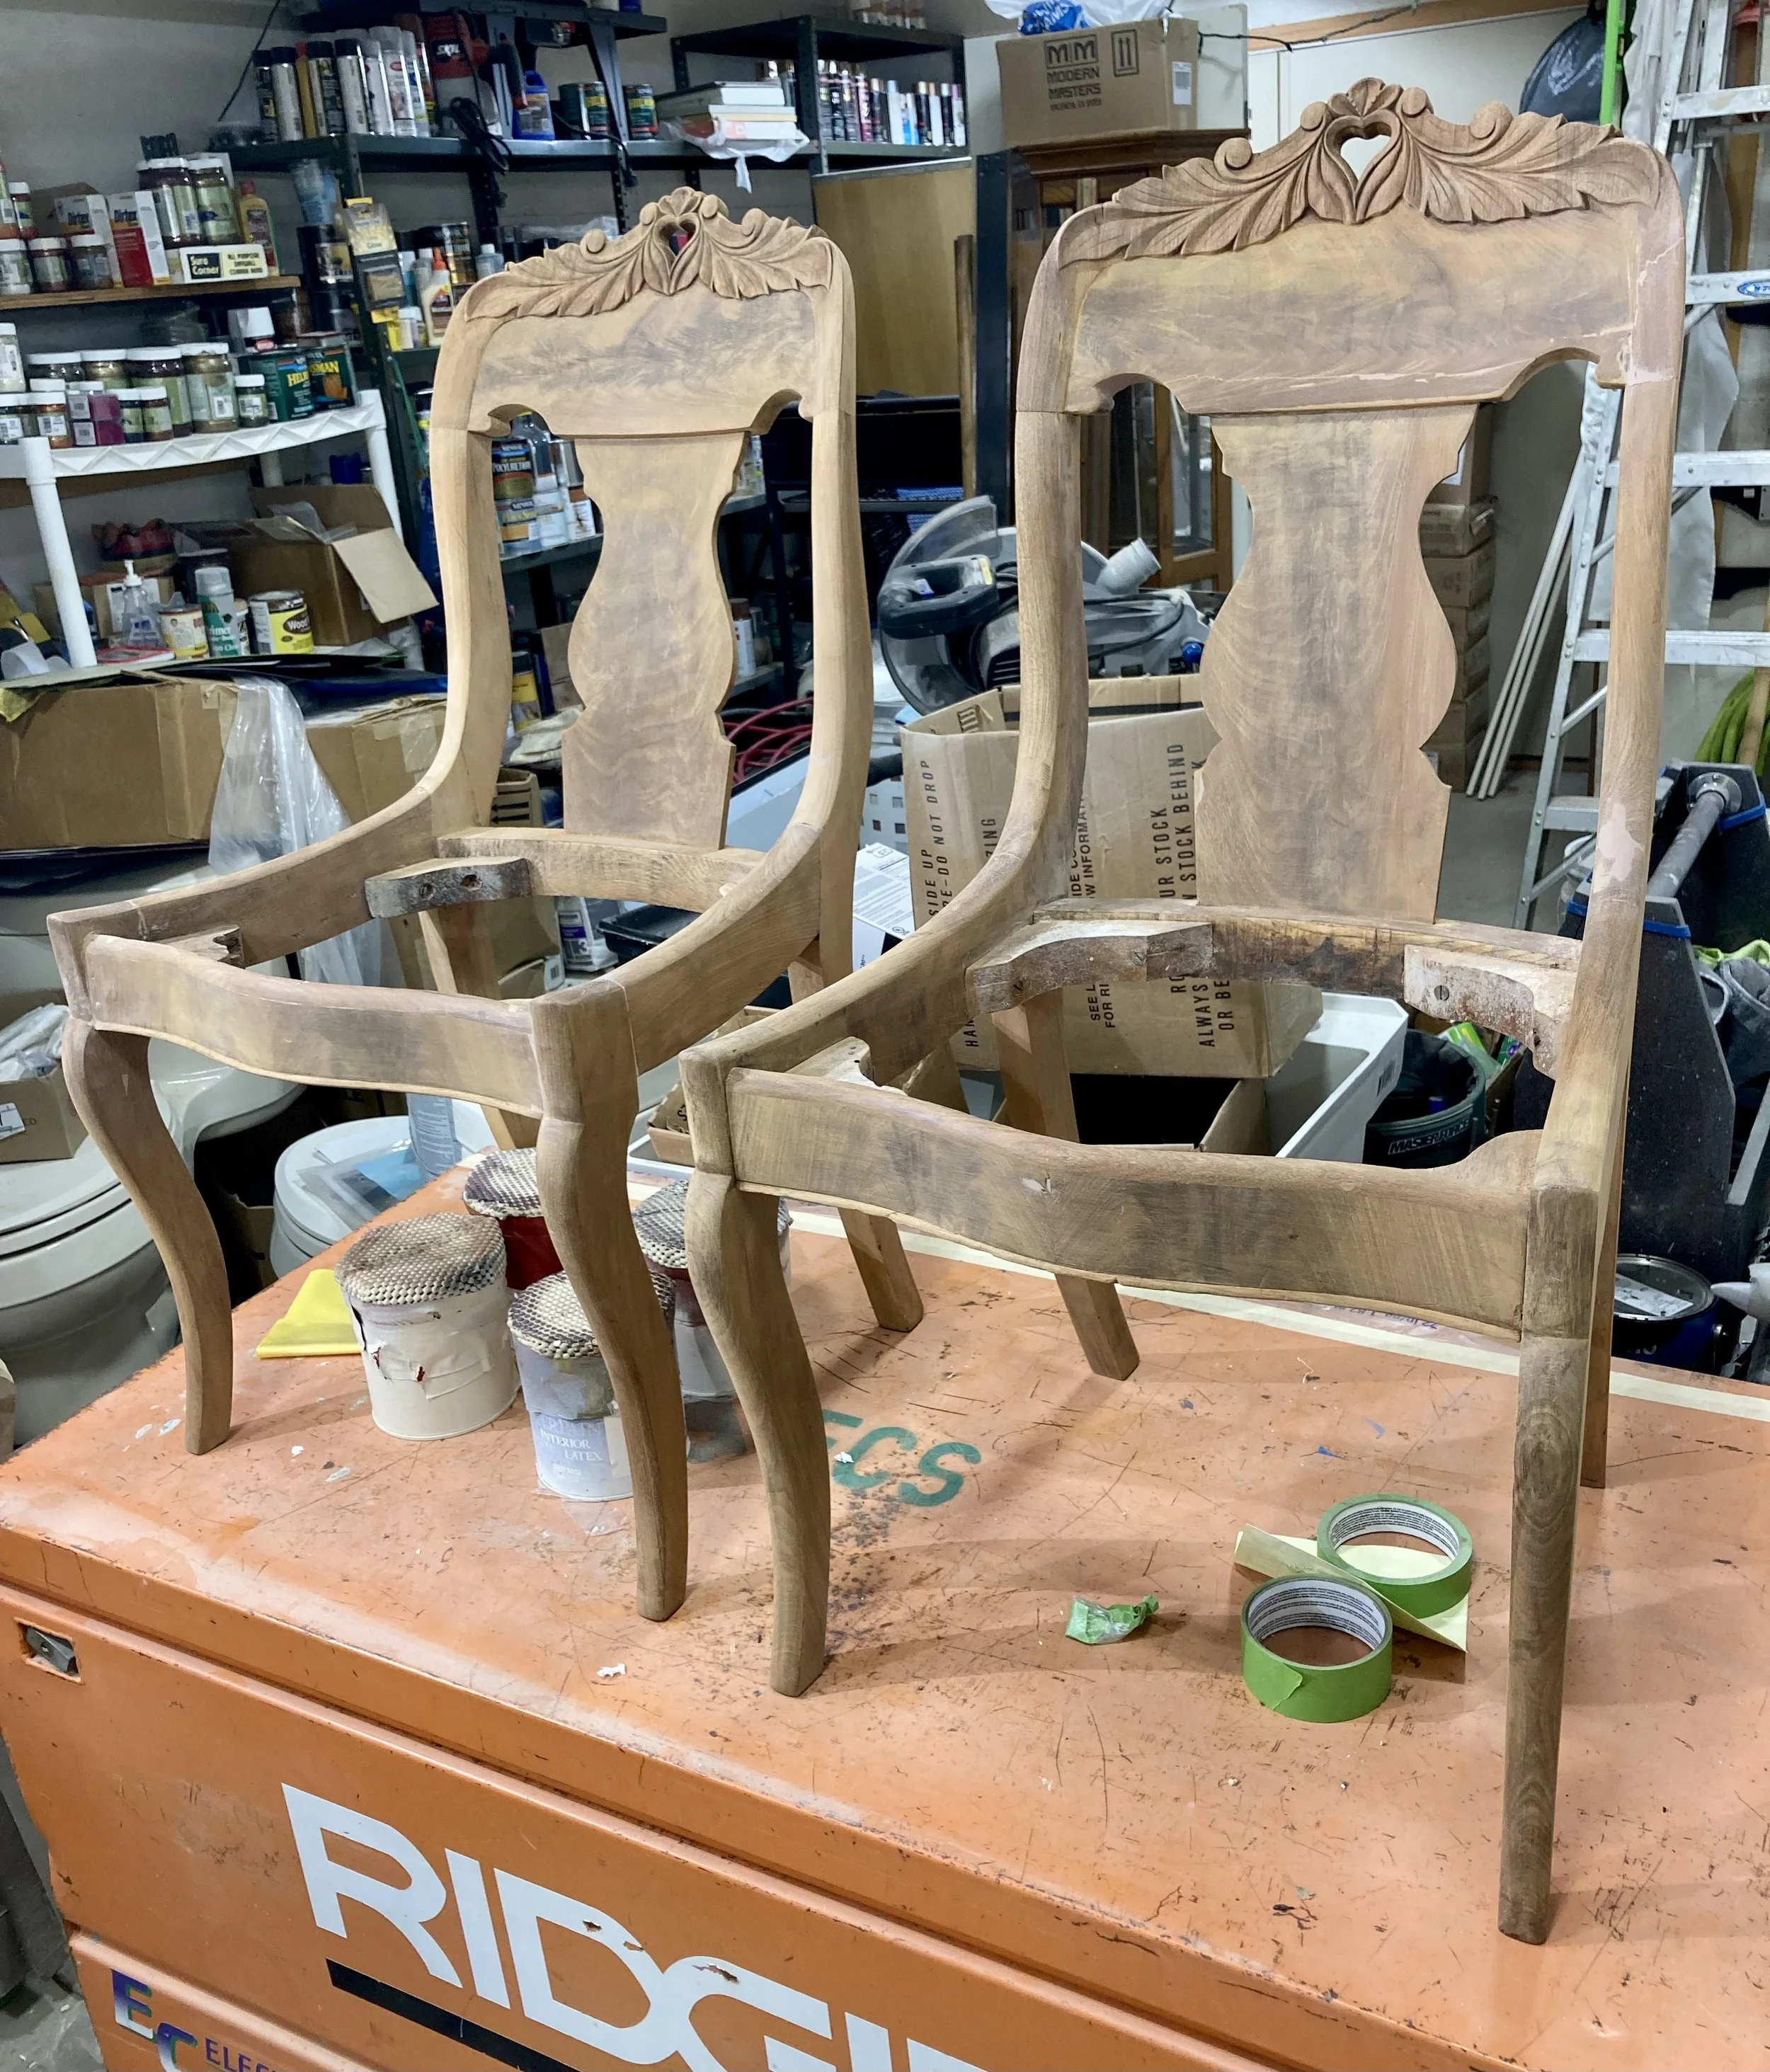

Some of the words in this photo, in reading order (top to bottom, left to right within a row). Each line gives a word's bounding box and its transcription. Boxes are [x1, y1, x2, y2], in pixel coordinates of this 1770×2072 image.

[1046, 67, 1100, 84] MODERN
[1049, 82, 1102, 100] MASTERS
[920, 760, 939, 803] DROP
[1167, 744, 1191, 813] BEHIND
[930, 815, 945, 845] NOT
[1150, 808, 1172, 865] STOCK
[921, 849, 934, 869] UP
[1174, 825, 1197, 881] STOCK
[924, 879, 940, 916] SIDE
[1214, 980, 1232, 1000] BE
[1087, 996, 1101, 1021] SEE
[1102, 1002, 1116, 1028] FOR
[1192, 985, 1215, 1048] ALWAYS
[1218, 1011, 1235, 1031] OR
[540, 1429, 591, 1450] INTERIOR
[564, 1449, 603, 1462] LATEX
